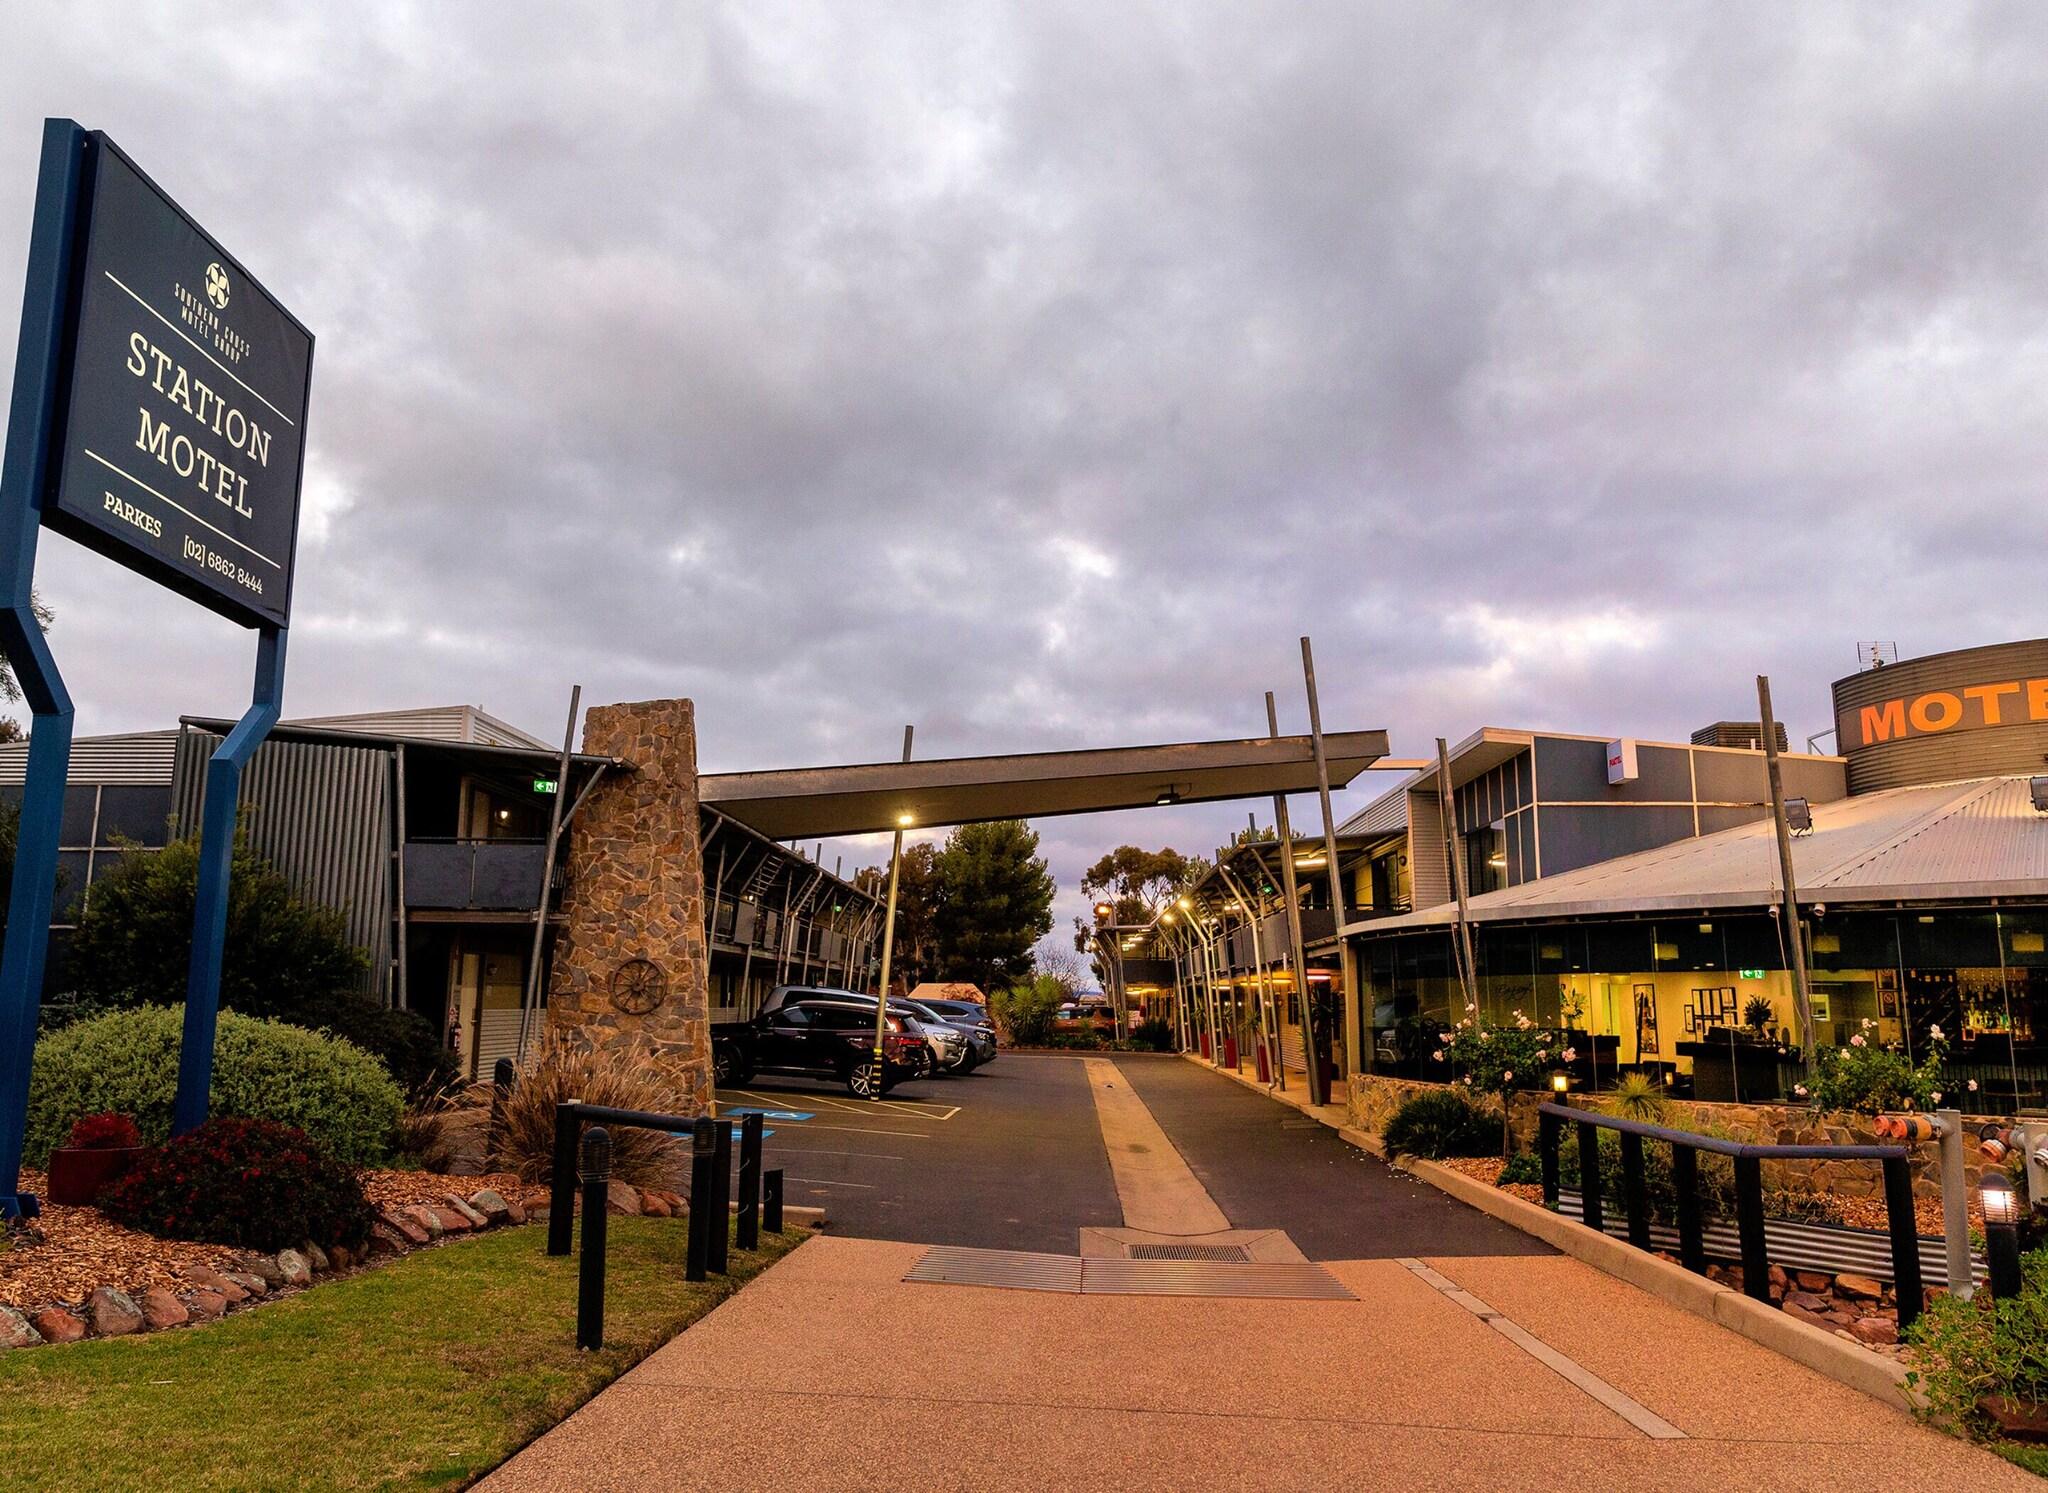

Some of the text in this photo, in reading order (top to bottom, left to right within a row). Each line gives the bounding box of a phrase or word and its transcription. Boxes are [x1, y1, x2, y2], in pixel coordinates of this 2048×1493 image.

[174, 282, 251, 357] SOUTHERN CROSS
[181, 305, 241, 364] MOTEL GROUP
[126, 332, 272, 467] STATION
[135, 407, 252, 520] MOTEL
[103, 491, 162, 538] PARKES
[207, 550, 235, 580] 6862
[237, 566, 263, 594] 8444
